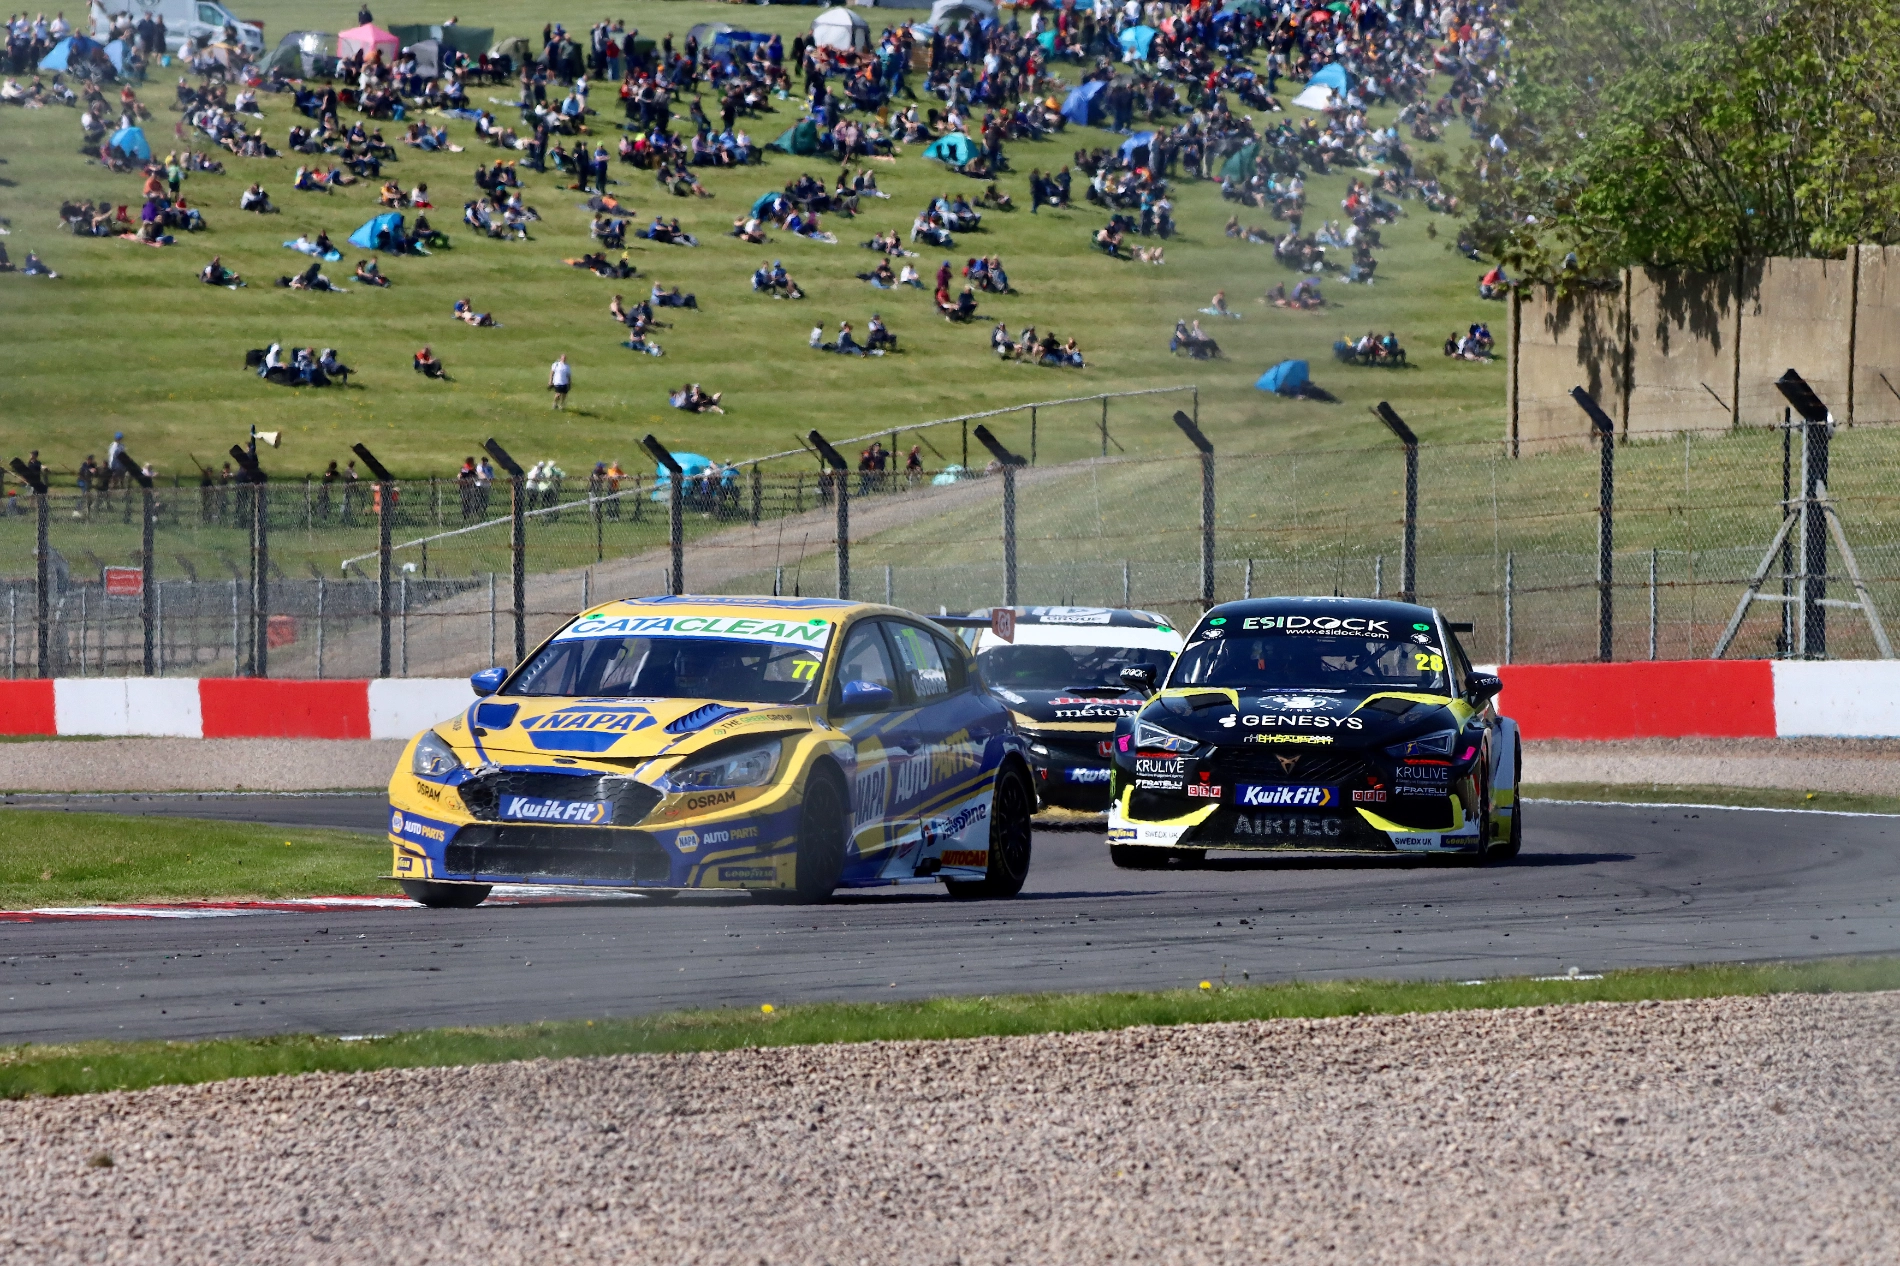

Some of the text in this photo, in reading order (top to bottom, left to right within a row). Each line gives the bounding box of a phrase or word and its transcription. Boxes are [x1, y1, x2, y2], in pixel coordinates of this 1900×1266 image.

[571, 617, 828, 641] CATACLEAN
[1243, 616, 1389, 633] ESIDOCK
[1286, 628, 1389, 639] www.esidock.com
[791, 660, 821, 680] 77
[1414, 653, 1444, 672] 28
[1055, 708, 1138, 718] metcla
[1242, 715, 1363, 729] GENESYS
[538, 714, 638, 731] NAPA
[721, 719, 742, 730] THE
[894, 746, 931, 804] AUTO
[1136, 759, 1185, 773] KRULIVE
[1396, 766, 1448, 780] KRULIVE
[417, 781, 441, 802] OSRAM
[687, 791, 736, 810] OSRAM
[404, 820, 422, 835] AUTO
[421, 825, 445, 842] PARTS
[1234, 814, 1341, 835] AIRTEC
[678, 826, 758, 848] NAPA AUTO PARTS
[942, 850, 987, 866] AUTOCAR
